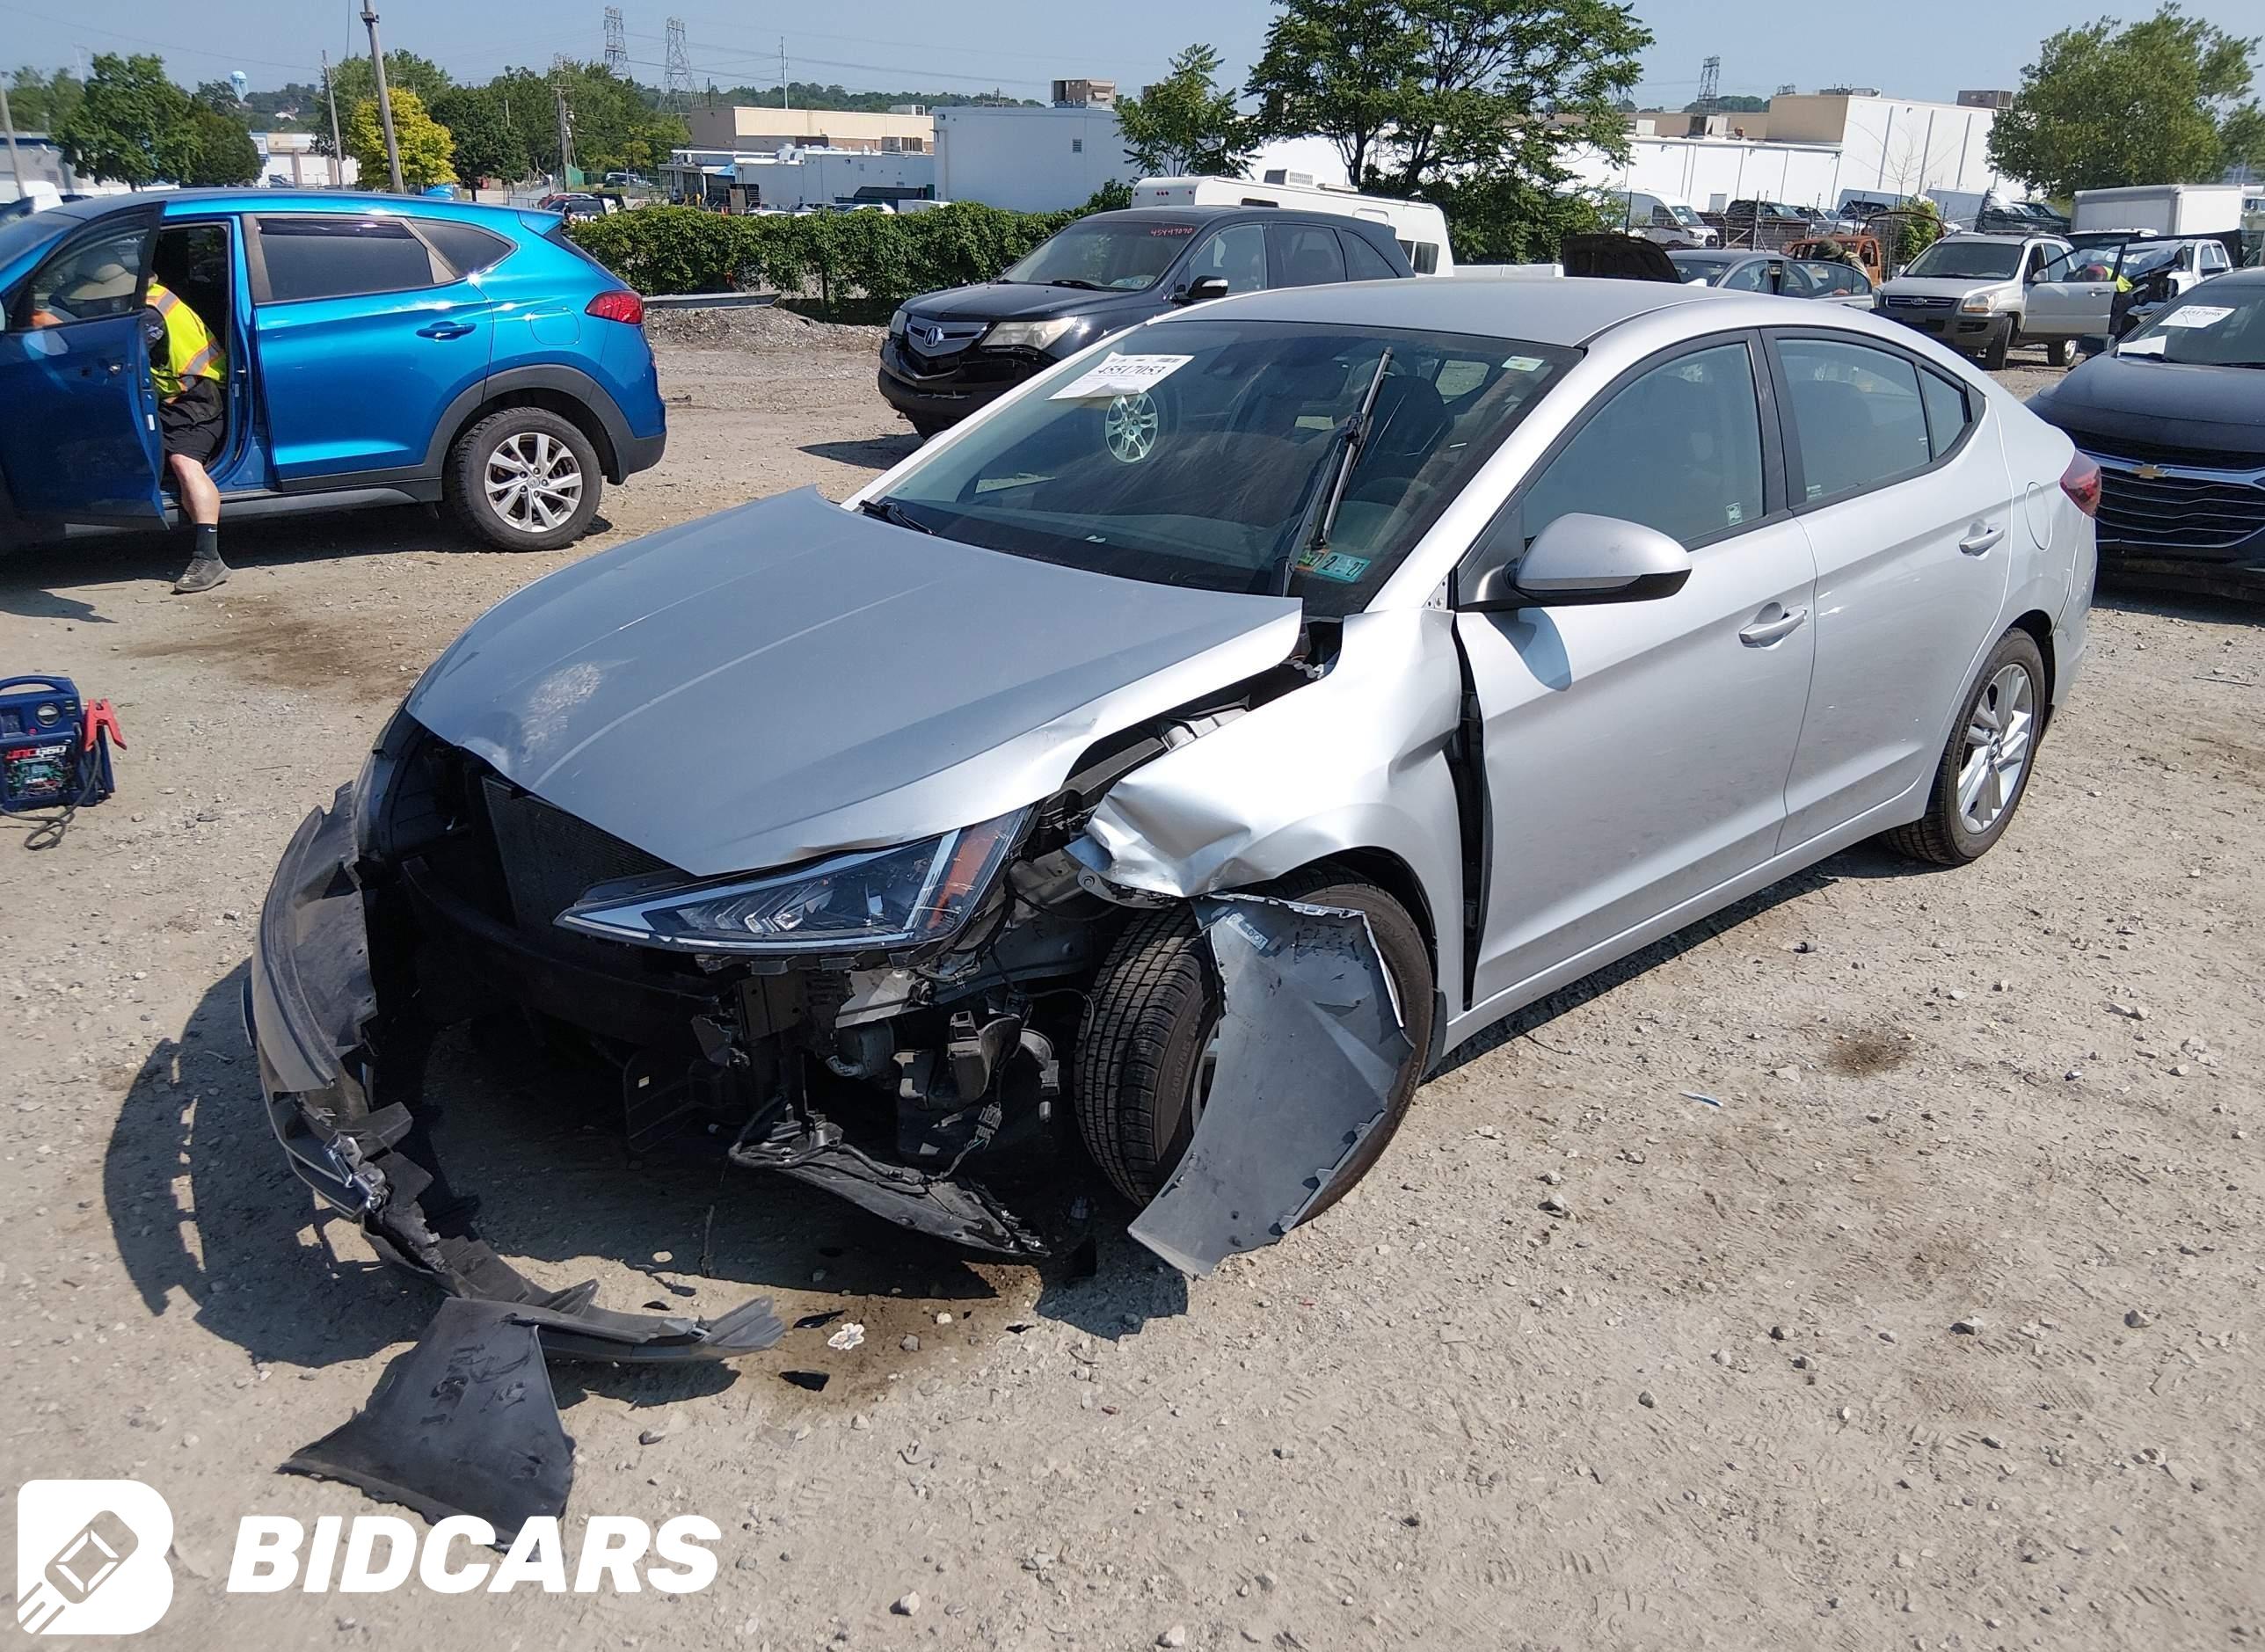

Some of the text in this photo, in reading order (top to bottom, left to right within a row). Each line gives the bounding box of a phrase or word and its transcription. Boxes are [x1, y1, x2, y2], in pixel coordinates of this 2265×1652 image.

[1322, 556, 1366, 577] 2 27
[1247, 928, 1267, 946] DOT
